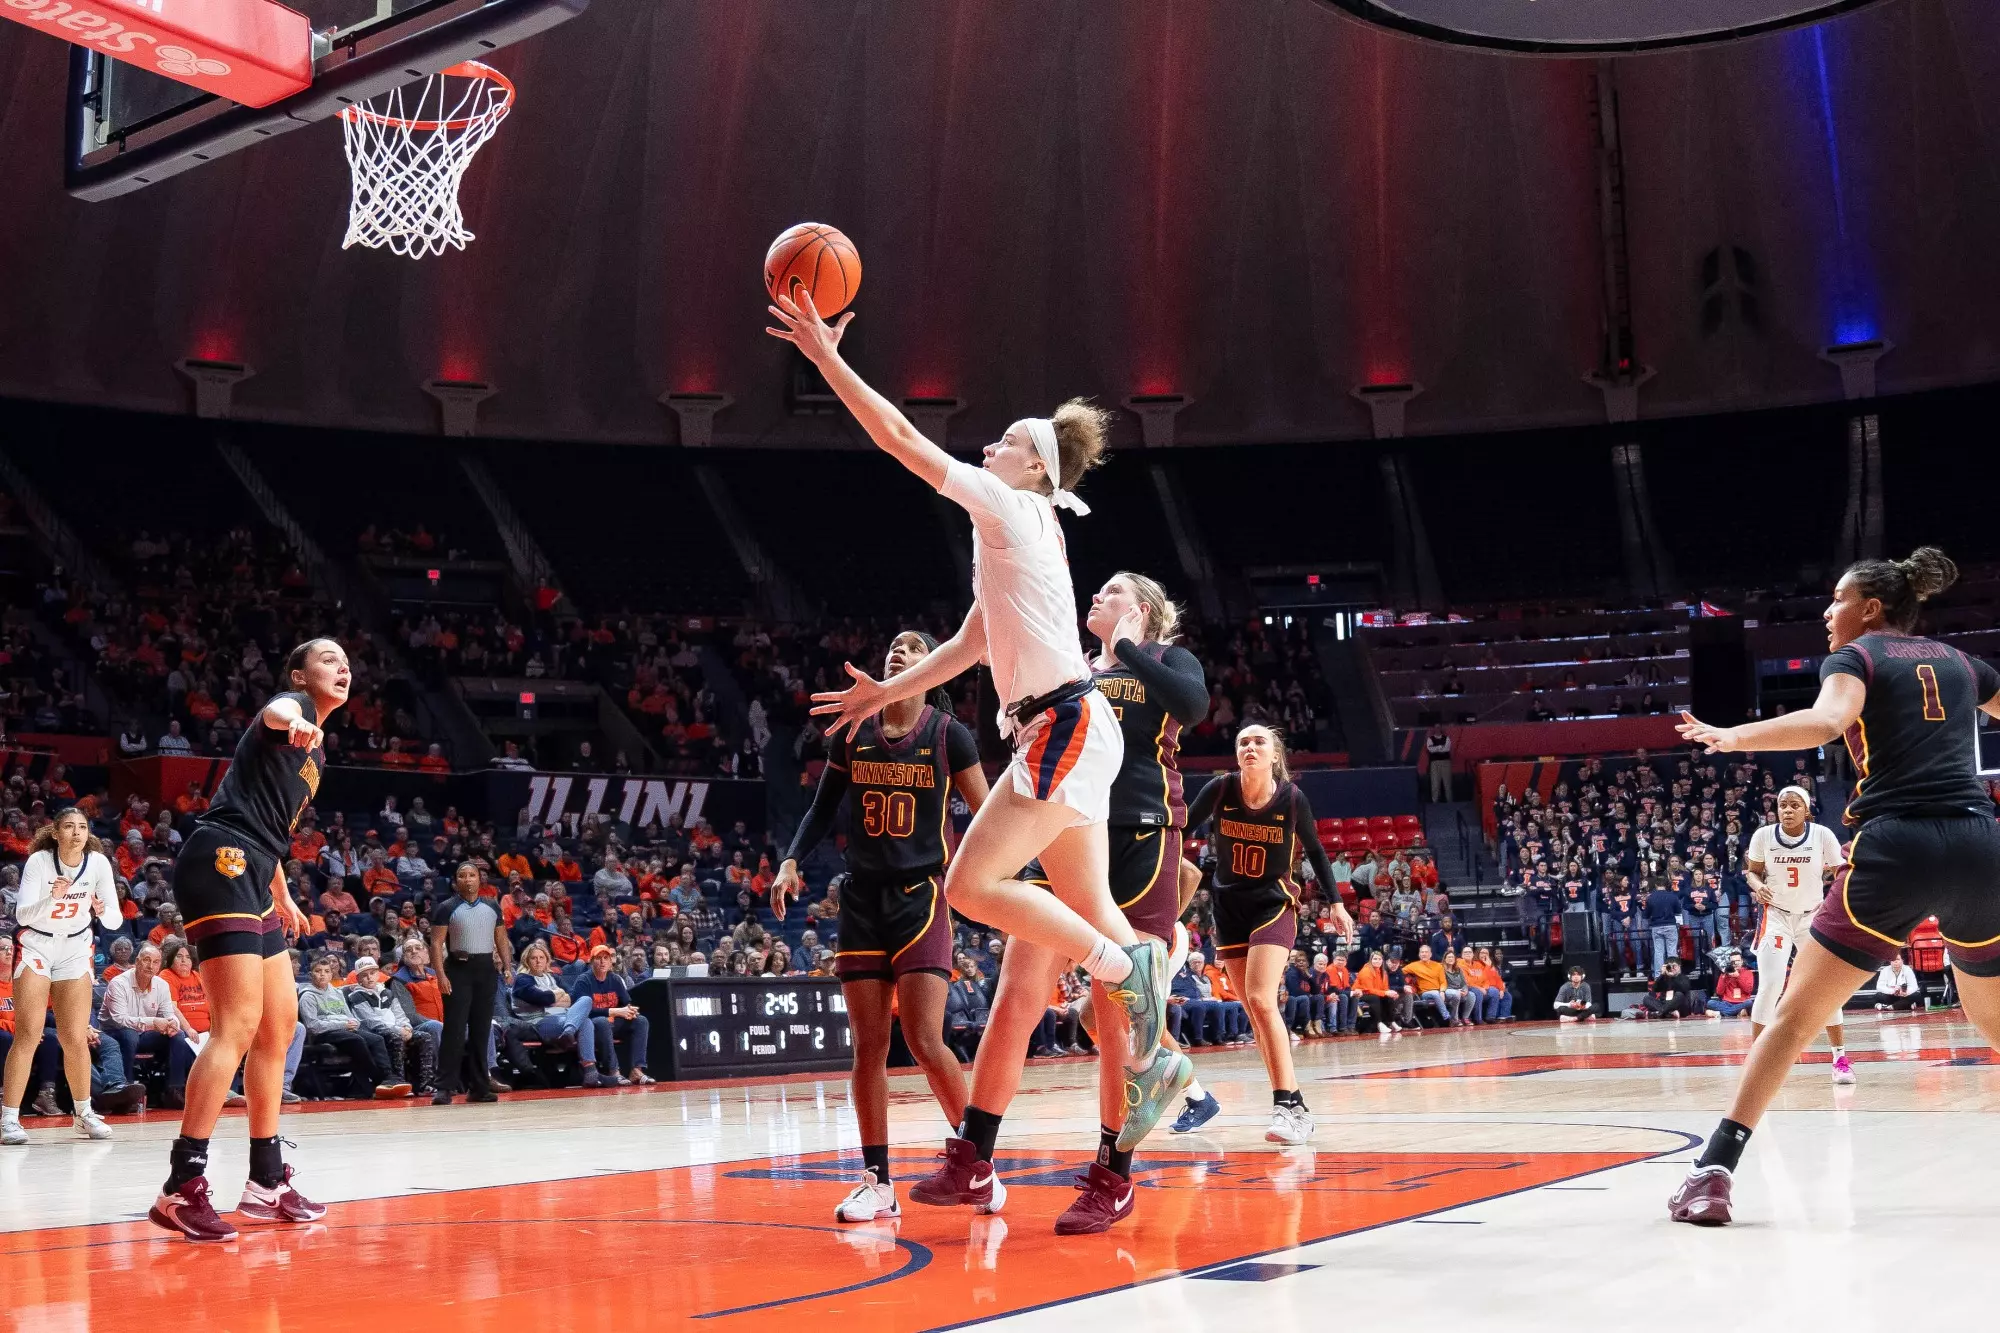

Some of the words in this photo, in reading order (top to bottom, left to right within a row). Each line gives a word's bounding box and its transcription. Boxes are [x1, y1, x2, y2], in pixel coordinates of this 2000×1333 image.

[1916, 664, 1946, 721] 1
[852, 760, 935, 788] MINNESOTA
[528, 776, 710, 829] ILLINI
[862, 790, 916, 837] 30
[1220, 817, 1284, 844] MINNESOTA
[1232, 842, 1266, 878] 10
[1773, 856, 1811, 864] ILLINOIS
[1786, 867, 1799, 887] 3
[51, 902, 79, 919] 23
[765, 992, 799, 1016] 2:45
[709, 1030, 720, 1052] 9
[749, 1025, 770, 1036] FOULS
[789, 1024, 810, 1035] FOULS
[814, 1026, 825, 1050] 2
[752, 1044, 776, 1055] PERIOD
